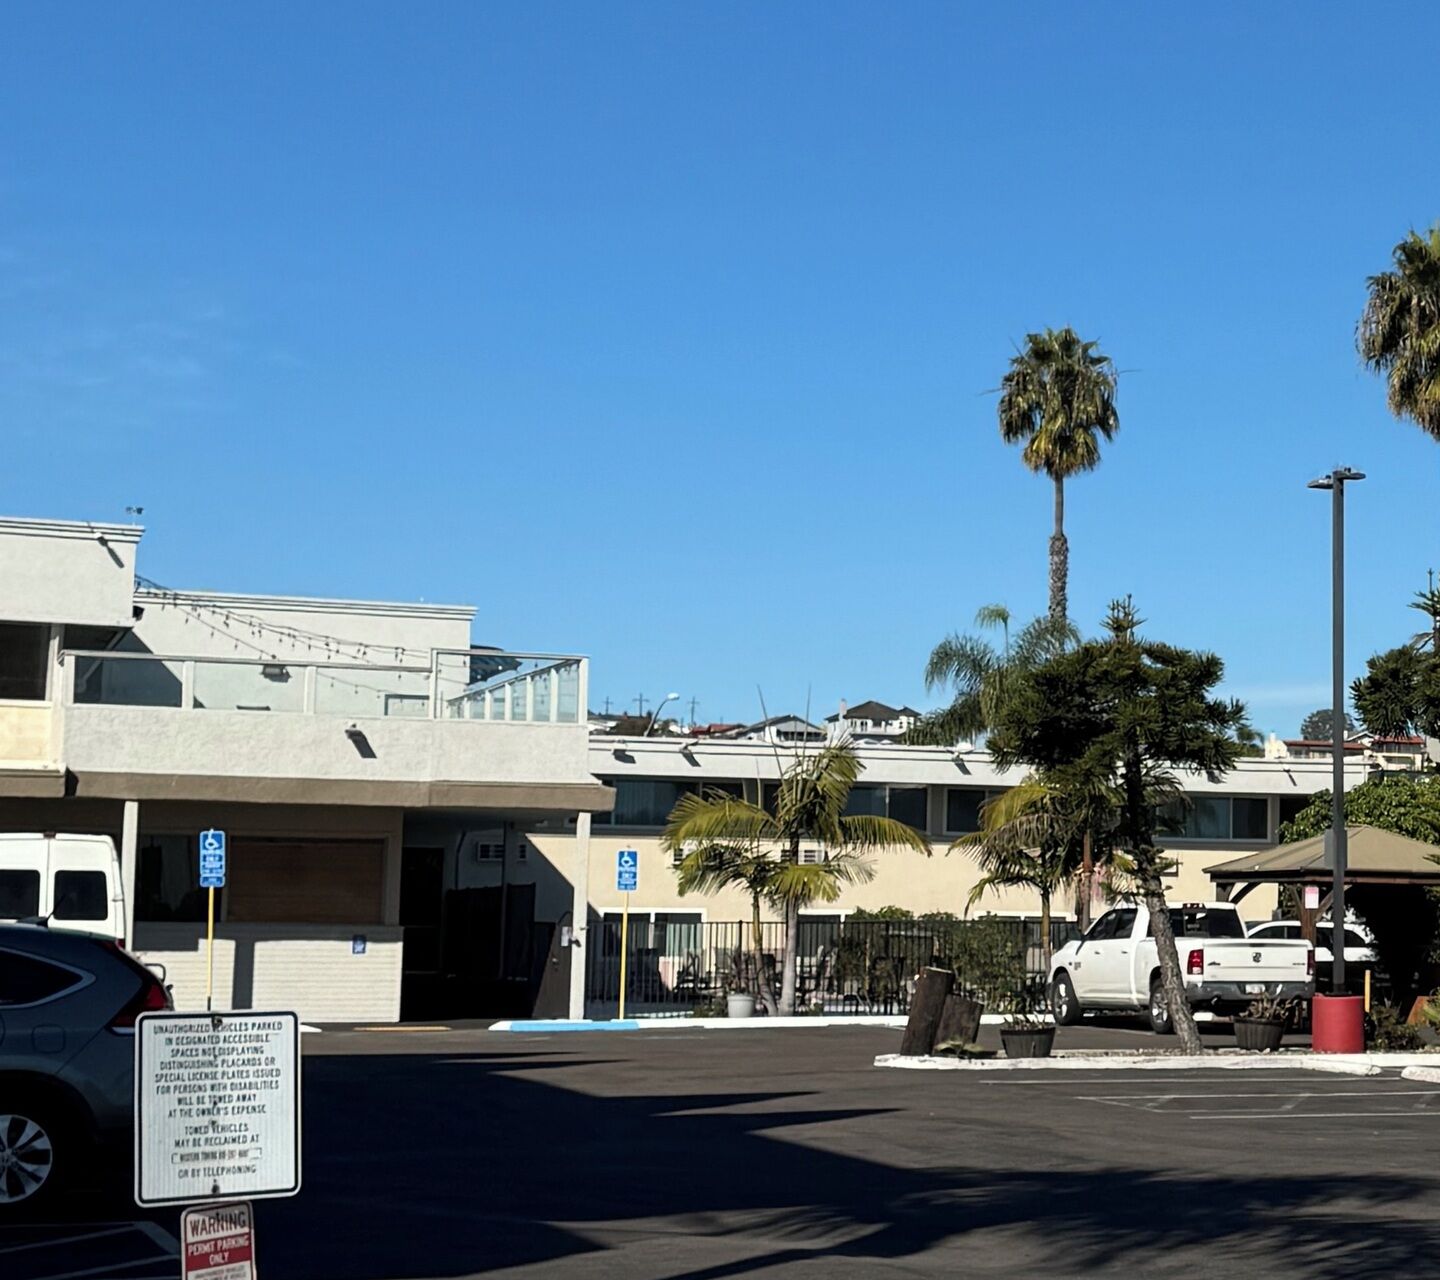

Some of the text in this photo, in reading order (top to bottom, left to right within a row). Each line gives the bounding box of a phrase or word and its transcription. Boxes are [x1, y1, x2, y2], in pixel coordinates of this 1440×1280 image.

[153, 1024, 210, 1034] UNAUTHORIZED
[251, 1021, 282, 1031] PARKED
[165, 1033, 270, 1046] IN DESIGNATED ACCESSIBLE
[171, 1048, 199, 1058] SPACES
[218, 1046, 264, 1056] DISPLAYING
[160, 1057, 276, 1070] DISTINGUISHING PLACARDS OR
[155, 1068, 281, 1083] SPECIAL LICENSE PLATES ISSUED
[156, 1080, 279, 1095] FOR PERSONS WITH DISABILITIES
[177, 1096, 193, 1106] WILL
[196, 1095, 206, 1105] BE
[236, 1093, 257, 1103] AWAY
[168, 1109, 177, 1119] AT
[179, 1108, 193, 1118] THE
[231, 1104, 266, 1115] EXPENSE
[185, 1123, 249, 1136] TOWED VEHICLES
[174, 1134, 260, 1148] MAY BE RECLAIMED AT
[178, 1164, 257, 1179] OR BY TELEPHONING
[189, 1211, 246, 1237] WARNING
[188, 1235, 249, 1257] PERMIT PARKING
[209, 1252, 230, 1266] ONLY
